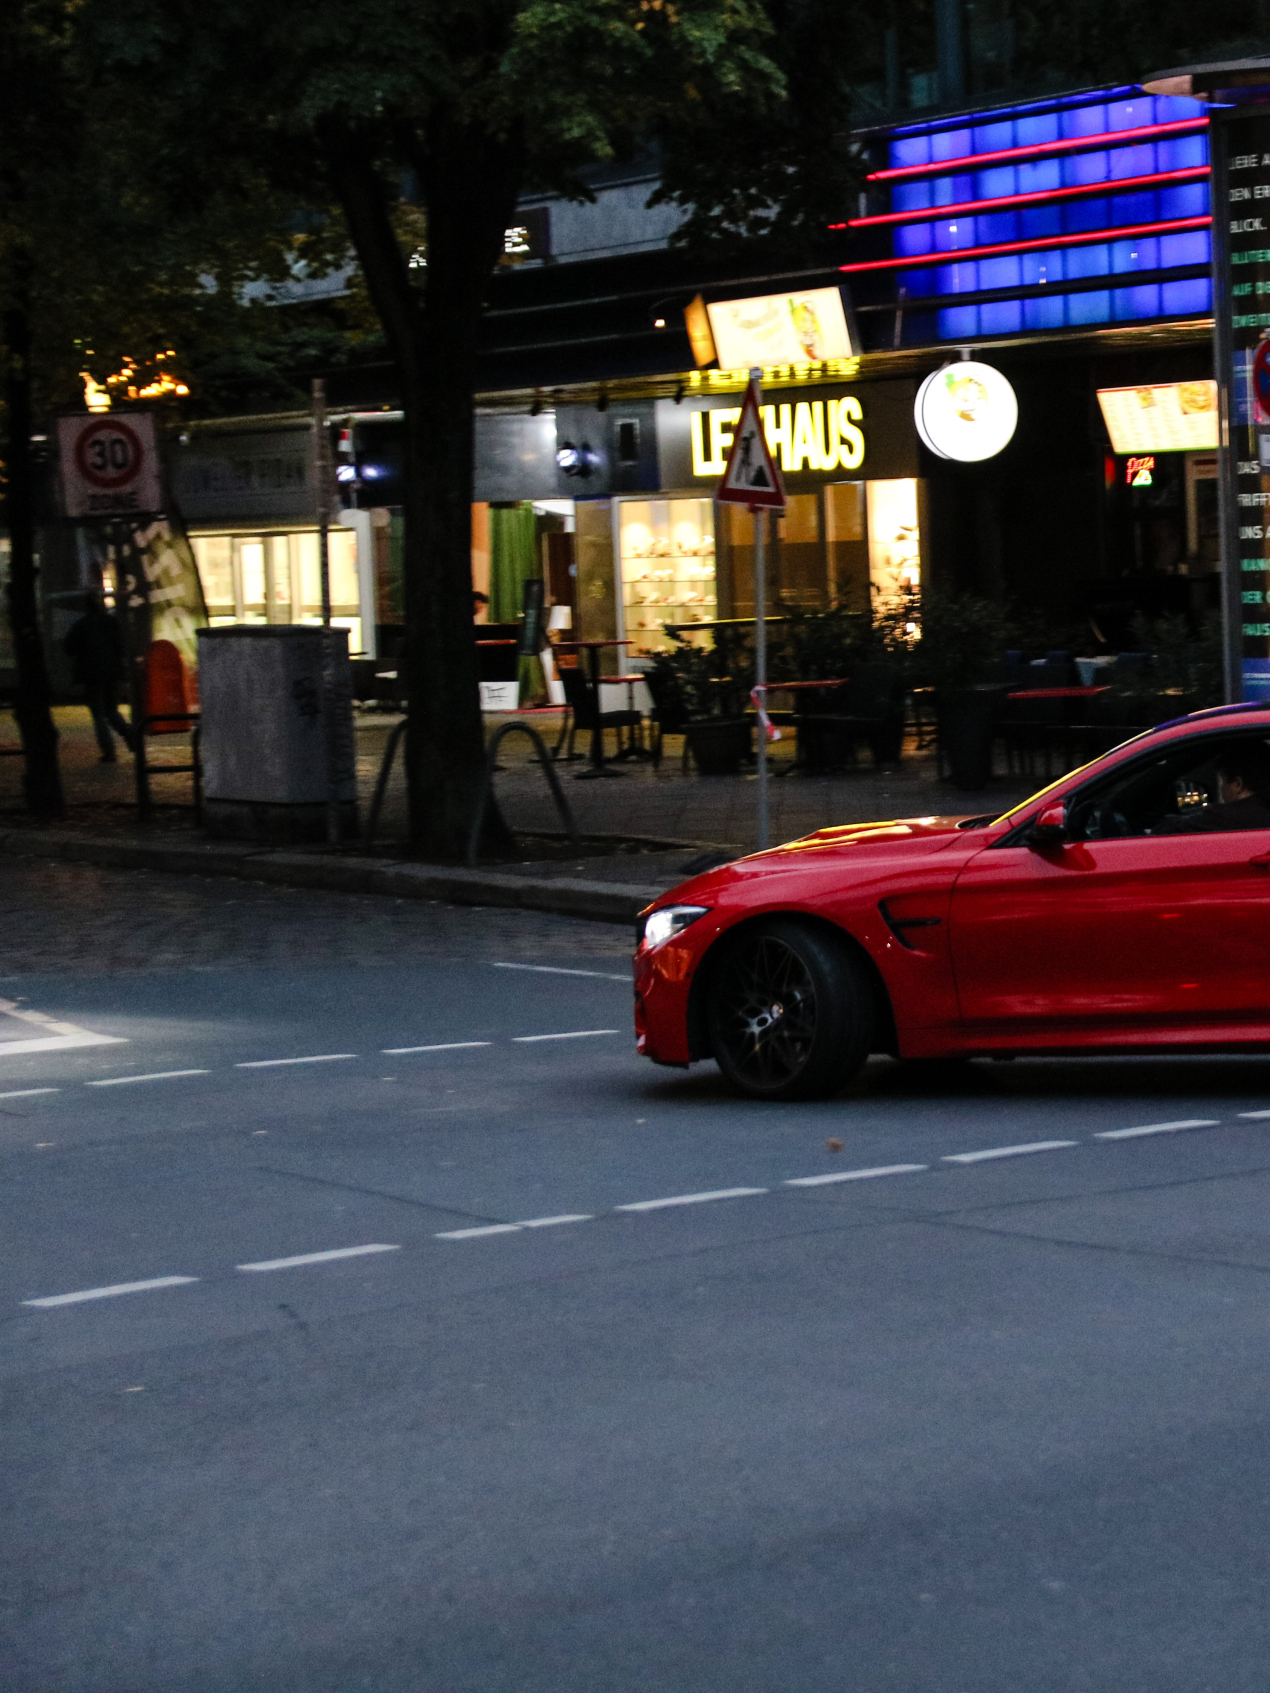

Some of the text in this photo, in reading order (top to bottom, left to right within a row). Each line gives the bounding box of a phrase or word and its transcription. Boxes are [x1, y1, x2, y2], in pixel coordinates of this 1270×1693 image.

[690, 396, 866, 477] LEHAUS
[89, 437, 129, 472] 30
[88, 491, 140, 512] ZONE
